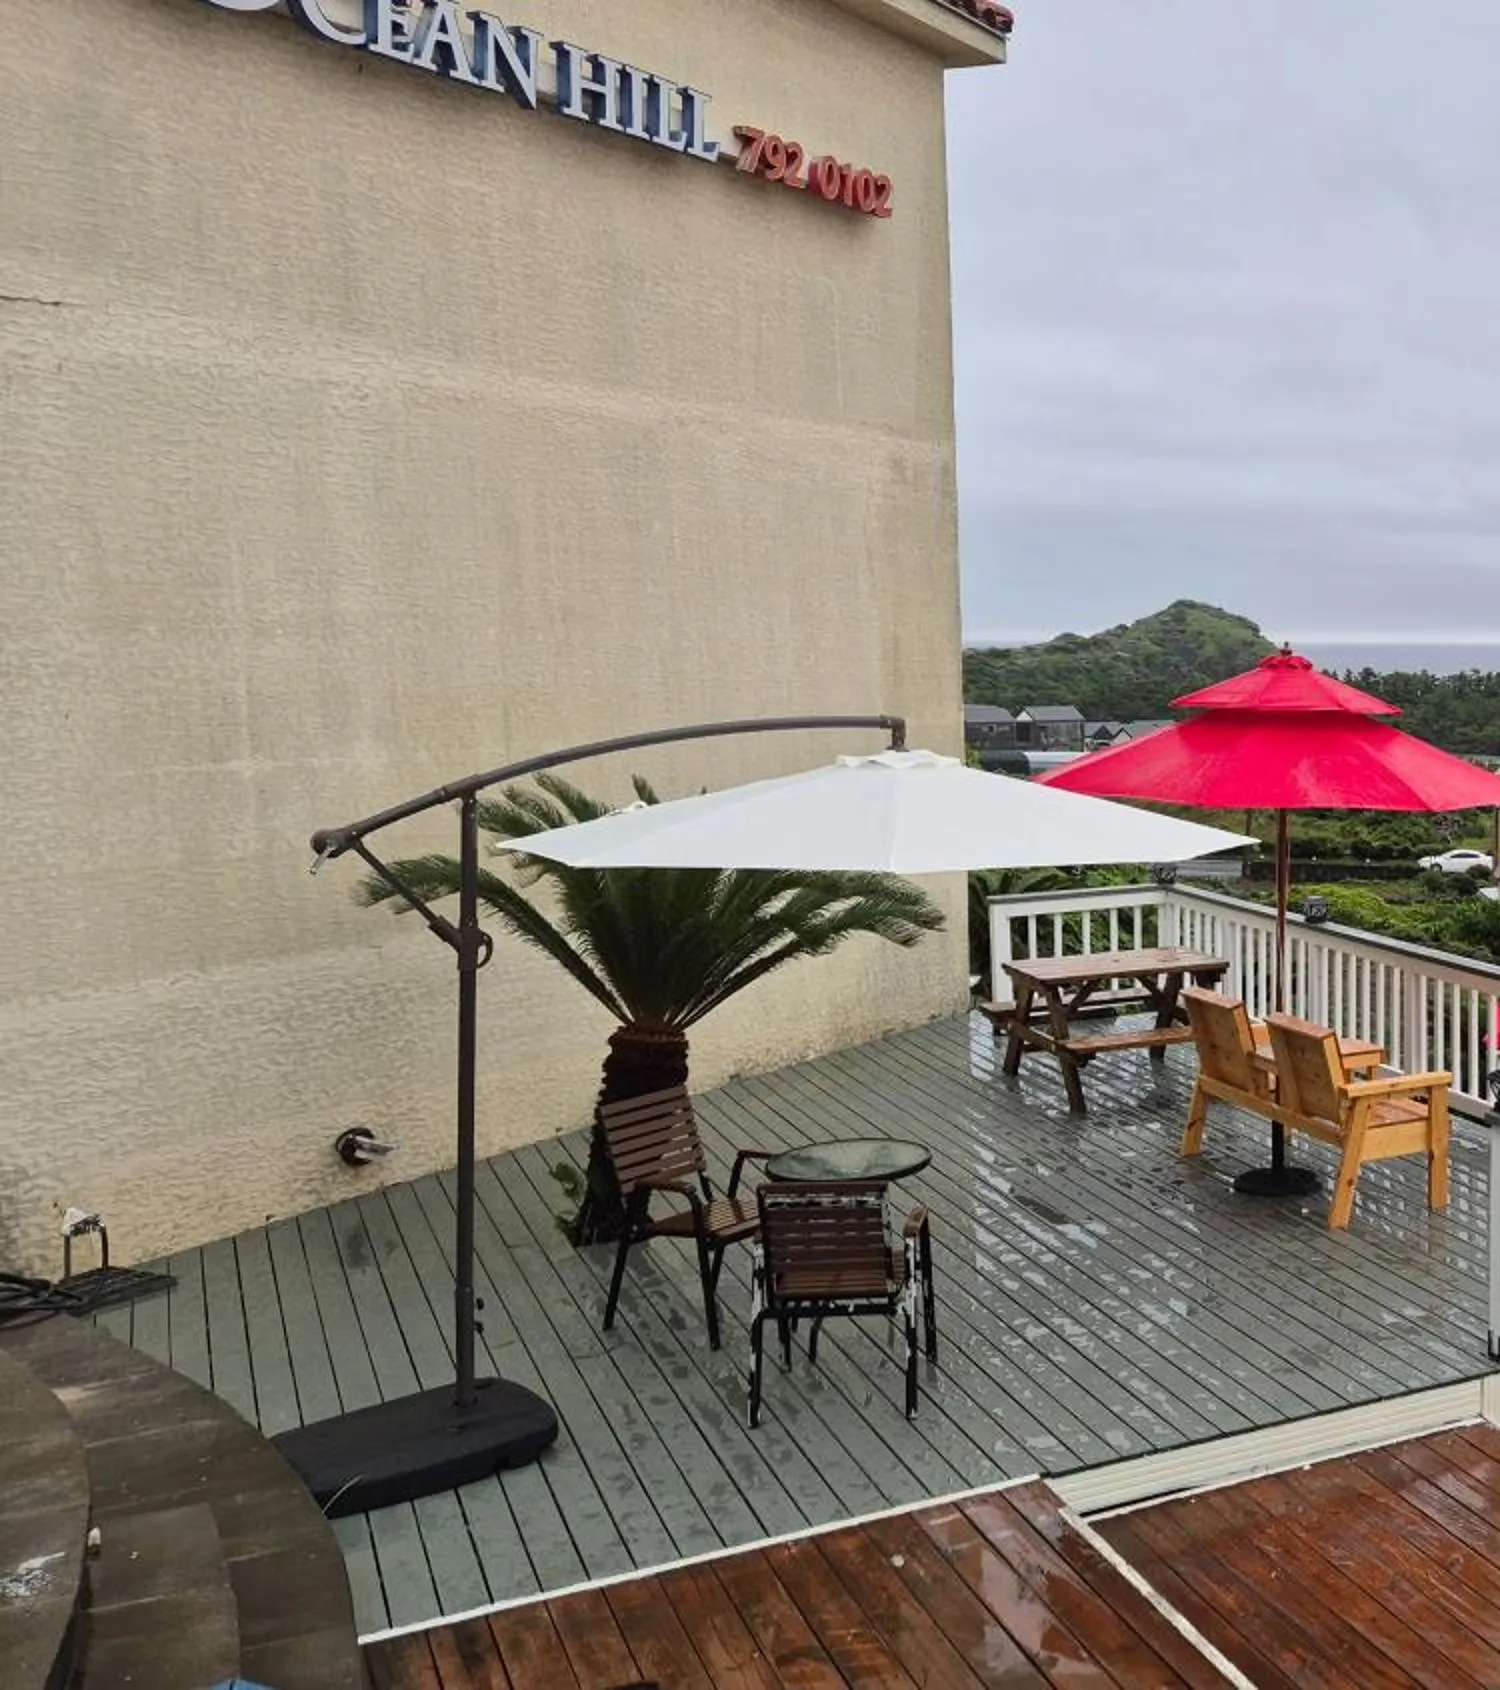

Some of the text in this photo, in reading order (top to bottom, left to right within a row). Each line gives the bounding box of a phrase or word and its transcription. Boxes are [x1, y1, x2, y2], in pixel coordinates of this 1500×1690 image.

[204, 0, 893, 218] CEAN HILL 792 0102
